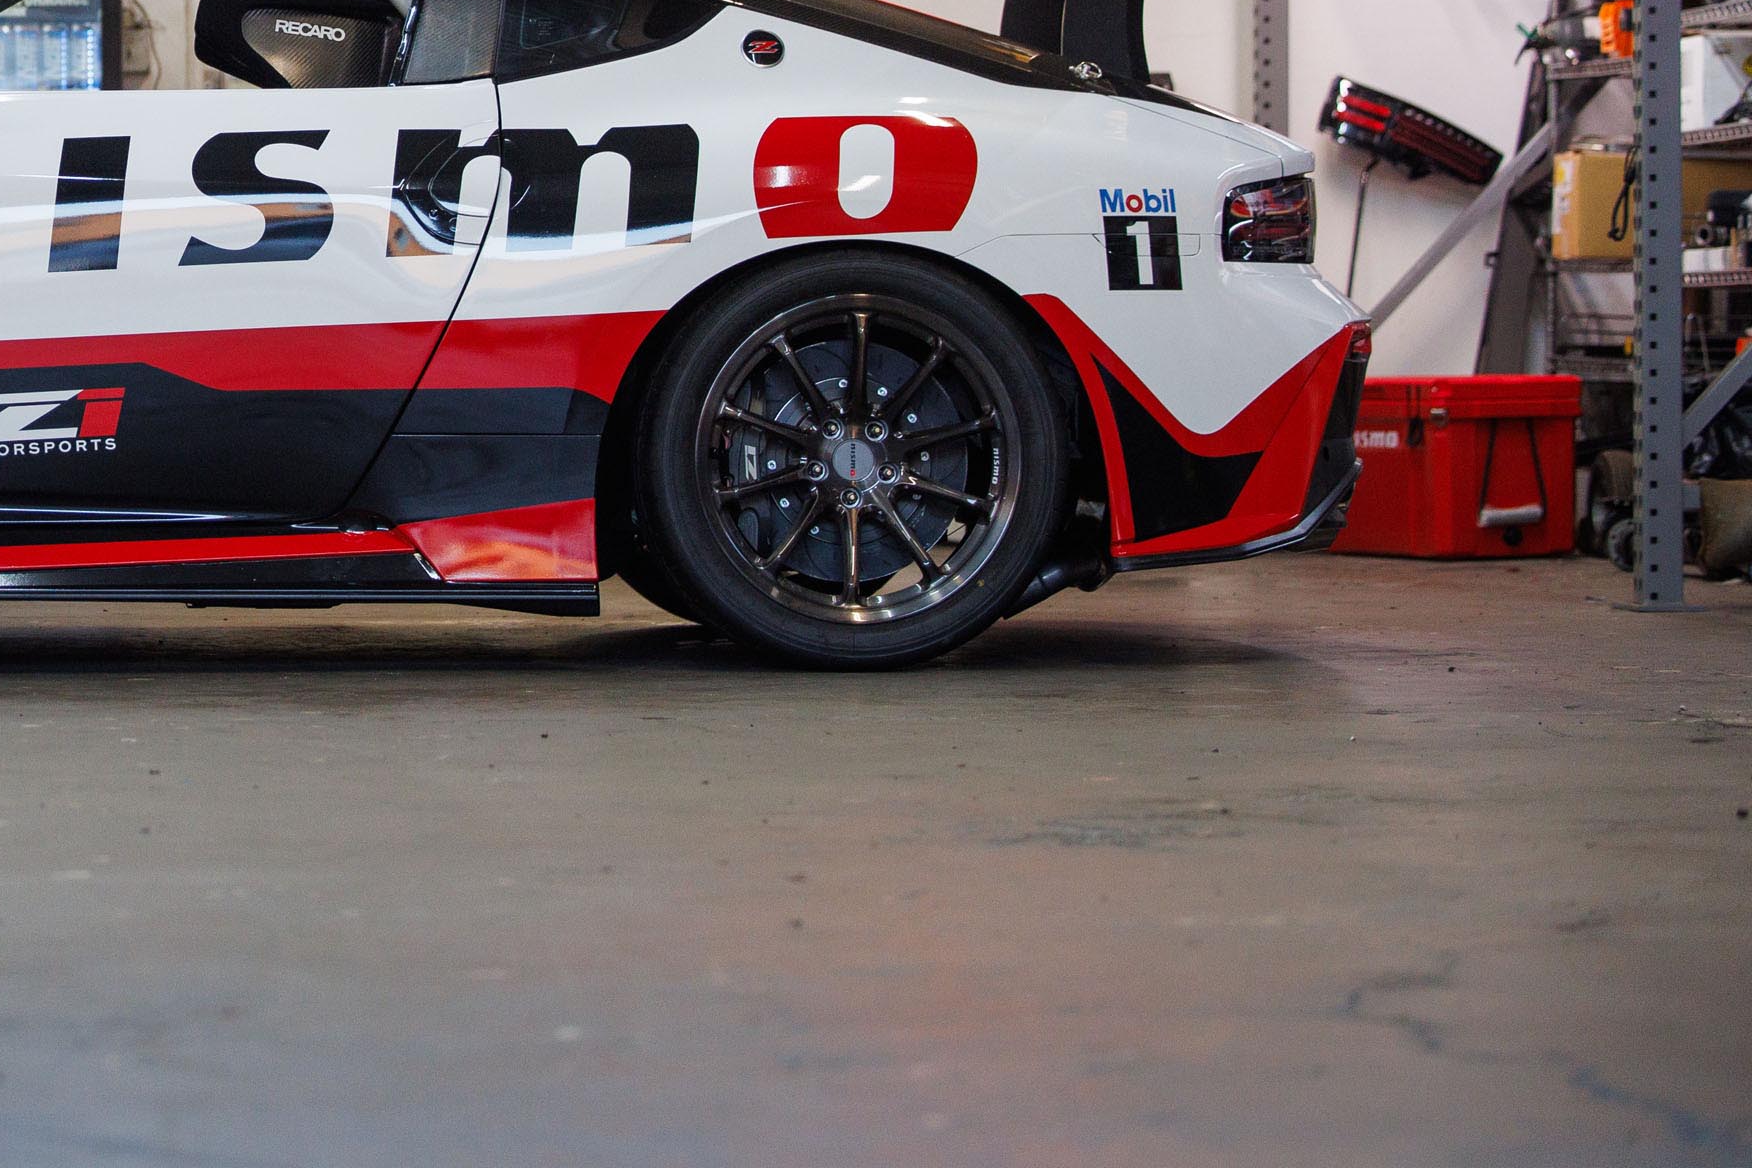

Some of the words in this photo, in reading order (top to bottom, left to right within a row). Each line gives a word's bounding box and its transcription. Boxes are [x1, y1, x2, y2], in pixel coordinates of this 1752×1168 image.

[275, 19, 346, 42] RECARO
[1098, 187, 1177, 213] Mobil
[1353, 430, 1399, 448] ismo
